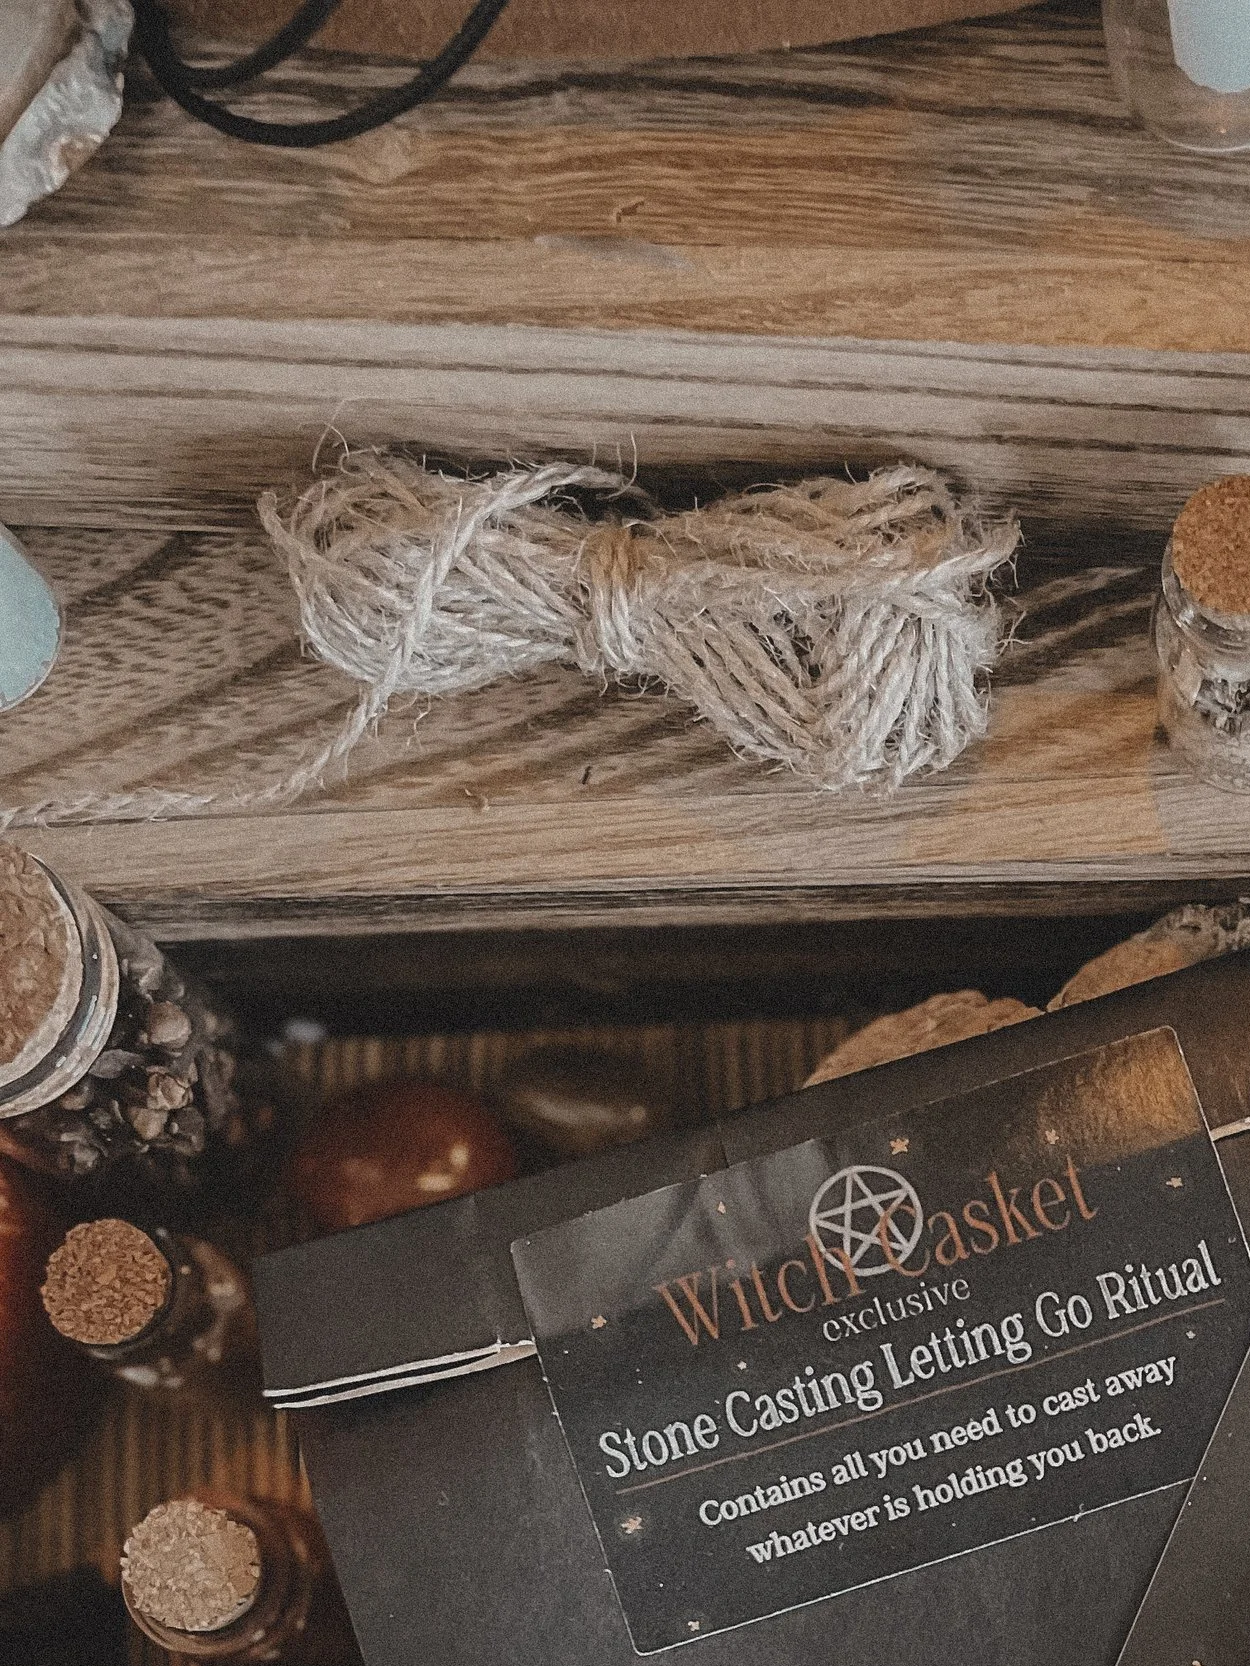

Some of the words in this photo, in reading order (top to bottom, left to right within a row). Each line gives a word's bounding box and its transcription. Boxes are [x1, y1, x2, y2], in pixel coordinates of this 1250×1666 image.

[652, 1230, 865, 1349] Witch
[879, 1155, 1099, 1279] Casket
[821, 1277, 971, 1342] exclusive
[599, 1413, 720, 1478] Stone
[724, 1359, 883, 1437] Casting
[878, 1311, 1032, 1389] Letting
[1034, 1290, 1093, 1337] Go
[1094, 1238, 1222, 1320] Ritual
[697, 1470, 827, 1526] Contains
[830, 1450, 869, 1485] all
[867, 1437, 928, 1479] you
[928, 1406, 1003, 1454] need
[1004, 1402, 1037, 1428] to
[1041, 1377, 1101, 1416] cast
[1103, 1355, 1176, 1397] away
[744, 1504, 881, 1564] whatever
[881, 1493, 911, 1521] is
[910, 1457, 1029, 1512] holding
[1025, 1439, 1085, 1481] you
[1083, 1411, 1162, 1454] back.
